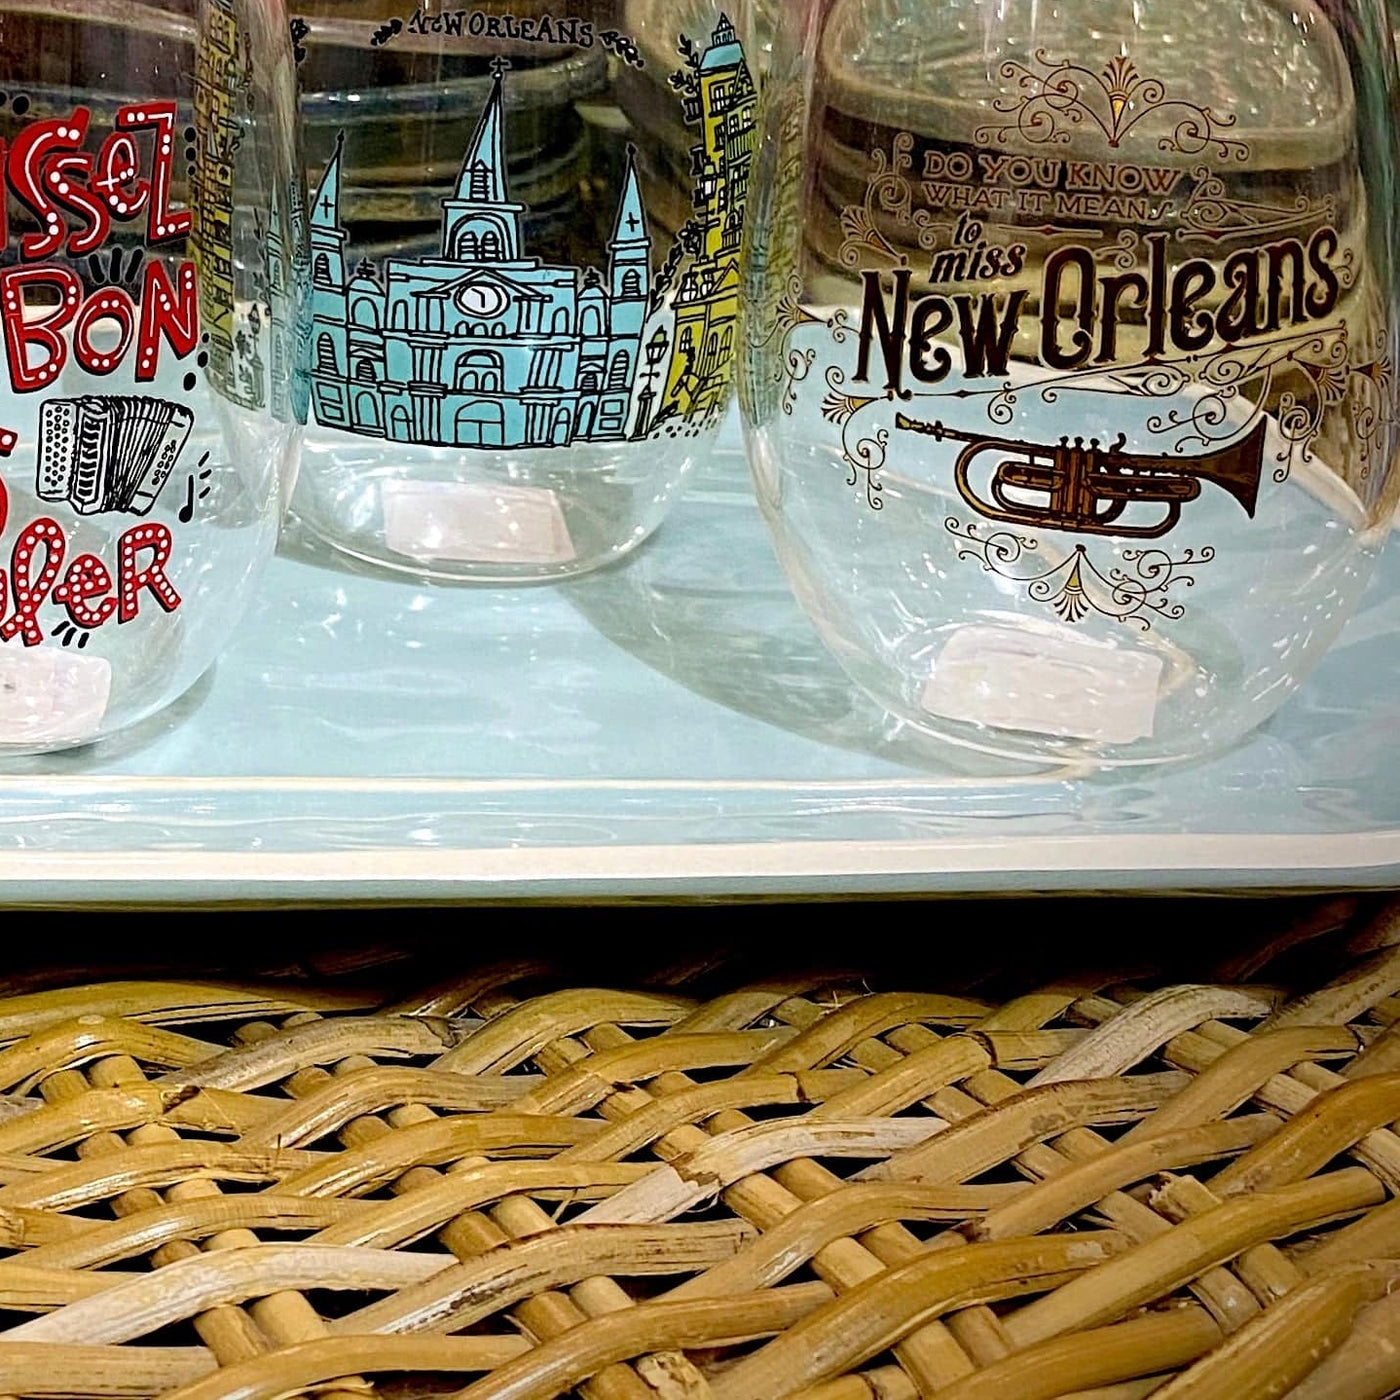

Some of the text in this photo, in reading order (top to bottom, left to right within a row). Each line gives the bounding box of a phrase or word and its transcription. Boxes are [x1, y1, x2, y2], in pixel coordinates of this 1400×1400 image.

[469, 11, 594, 48] ORLEANS
[923, 151, 1182, 194] DO YOU KNOW
[922, 183, 1174, 222] WHAT IT MEANS
[953, 211, 983, 245] to
[927, 241, 1027, 284] miss
[0, 260, 200, 393] BON
[850, 227, 1342, 399] New Orleans
